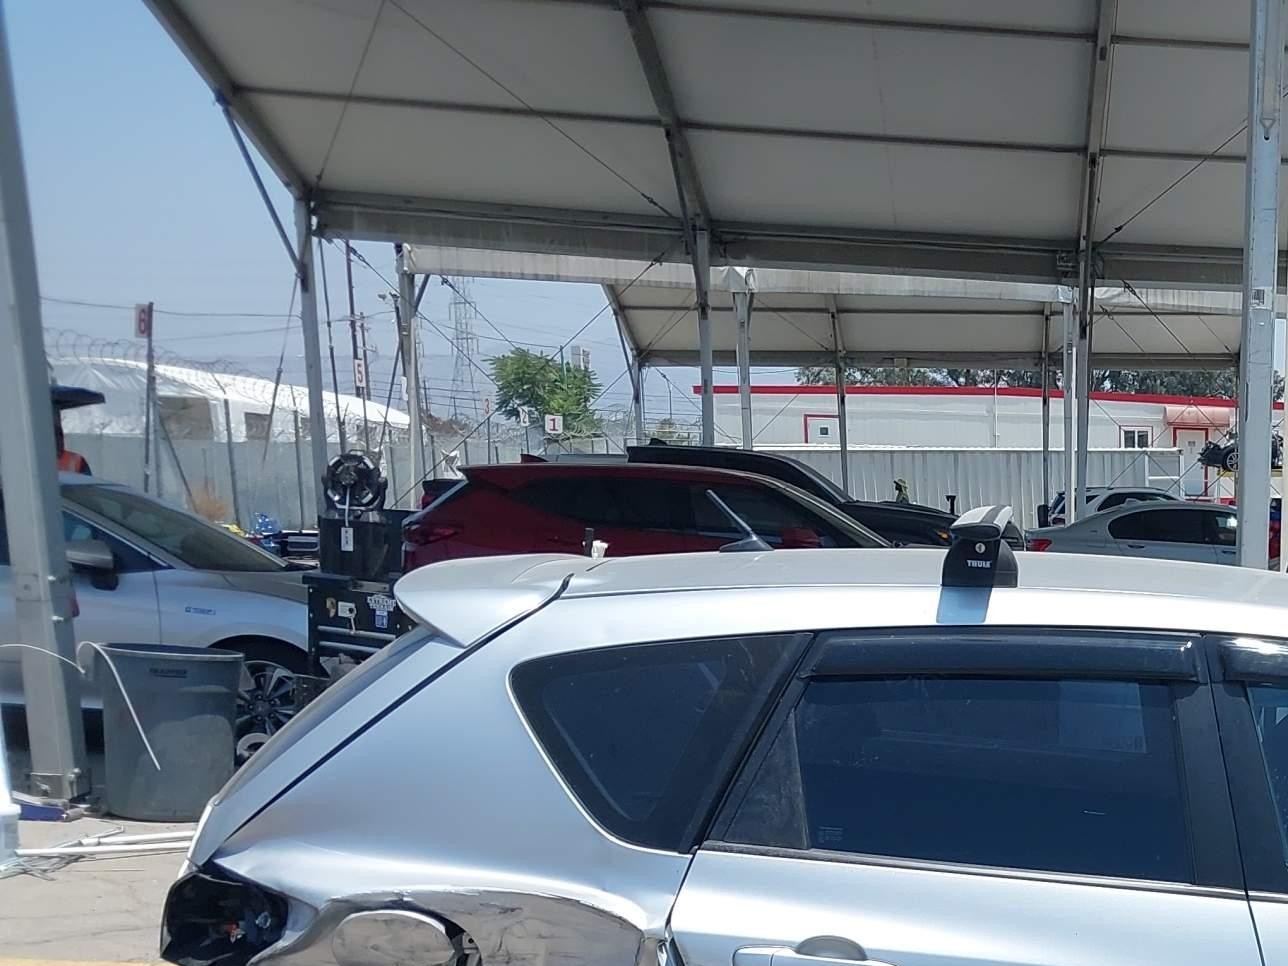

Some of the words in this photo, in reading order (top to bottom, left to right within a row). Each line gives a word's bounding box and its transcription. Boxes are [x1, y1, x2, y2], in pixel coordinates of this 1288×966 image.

[357, 363, 364, 383] 5
[549, 418, 558, 431] 1
[966, 559, 992, 568] THULE
